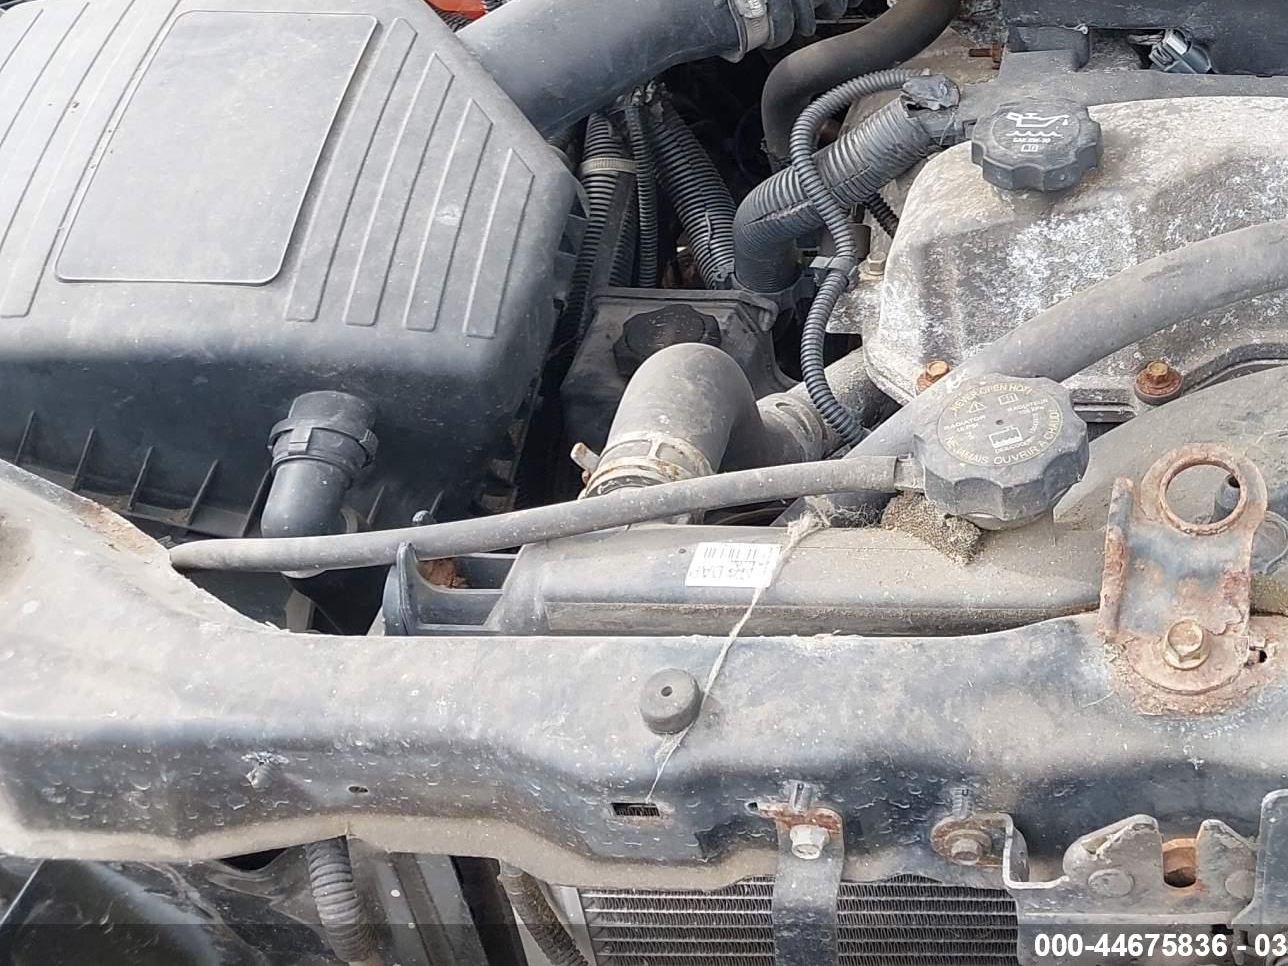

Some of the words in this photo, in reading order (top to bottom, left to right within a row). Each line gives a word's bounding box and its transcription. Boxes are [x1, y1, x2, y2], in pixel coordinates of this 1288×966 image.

[979, 383, 1008, 396] OPEN
[943, 414, 987, 431] RADIATOR
[955, 448, 990, 464] JAMAIS
[994, 446, 1039, 464] OUVRIR
